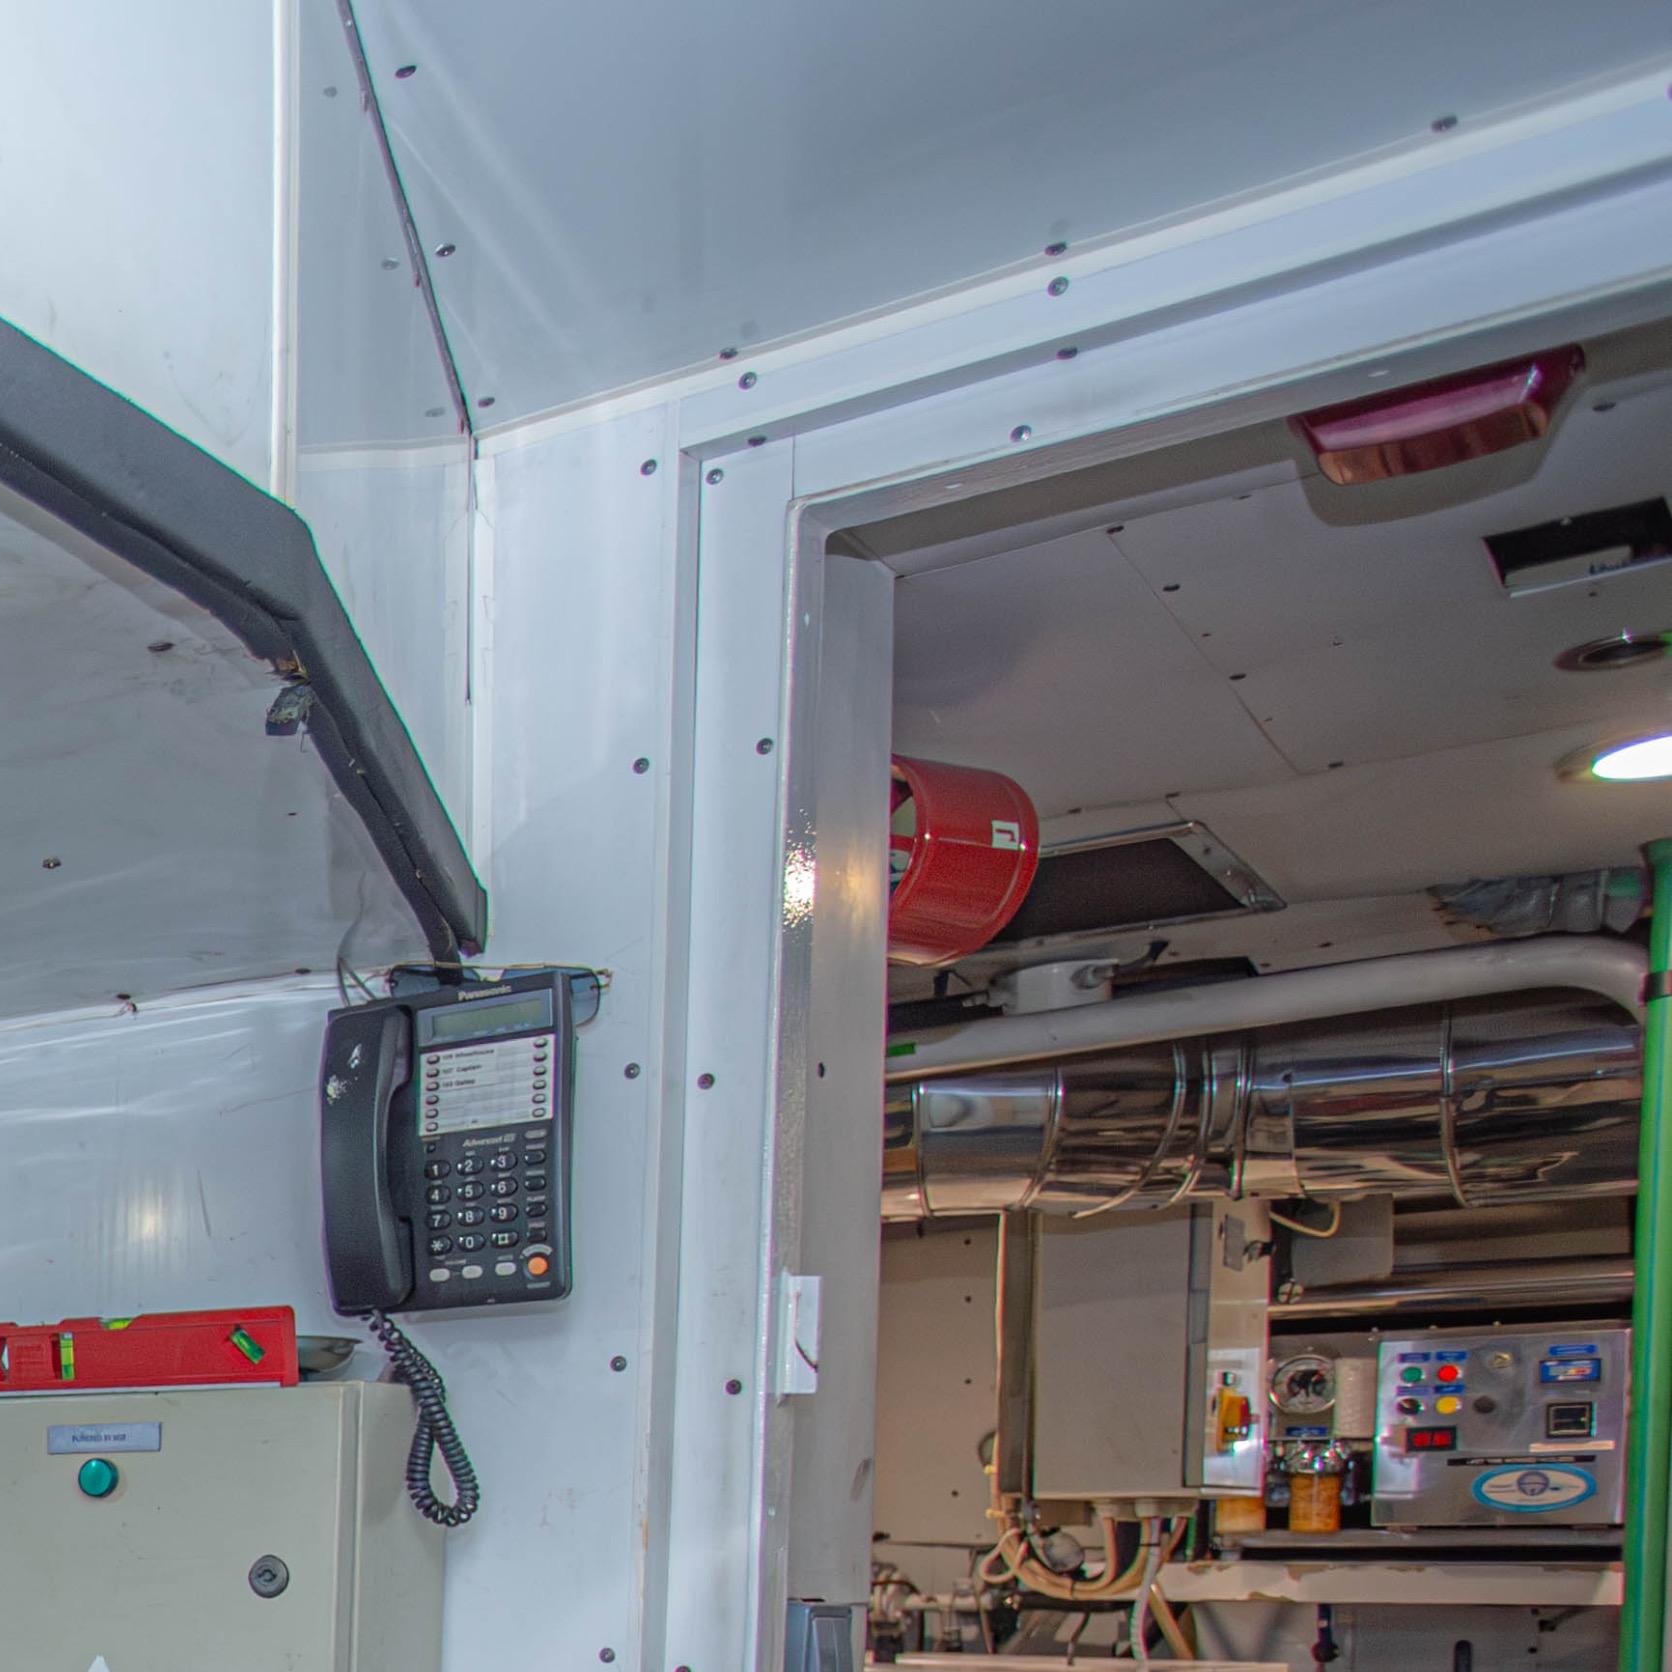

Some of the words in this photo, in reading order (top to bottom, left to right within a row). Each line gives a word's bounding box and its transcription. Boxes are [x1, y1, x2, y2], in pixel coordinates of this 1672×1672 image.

[465, 1160, 474, 1172] 2
[498, 1155, 507, 1168] 3
[465, 1184, 474, 1197] 5
[498, 1181, 507, 1194] 6
[431, 1189, 440, 1201] 4
[465, 1210, 474, 1223] 8
[498, 1206, 507, 1219] 9
[432, 1214, 441, 1227] 7
[465, 1236, 474, 1249] 0
